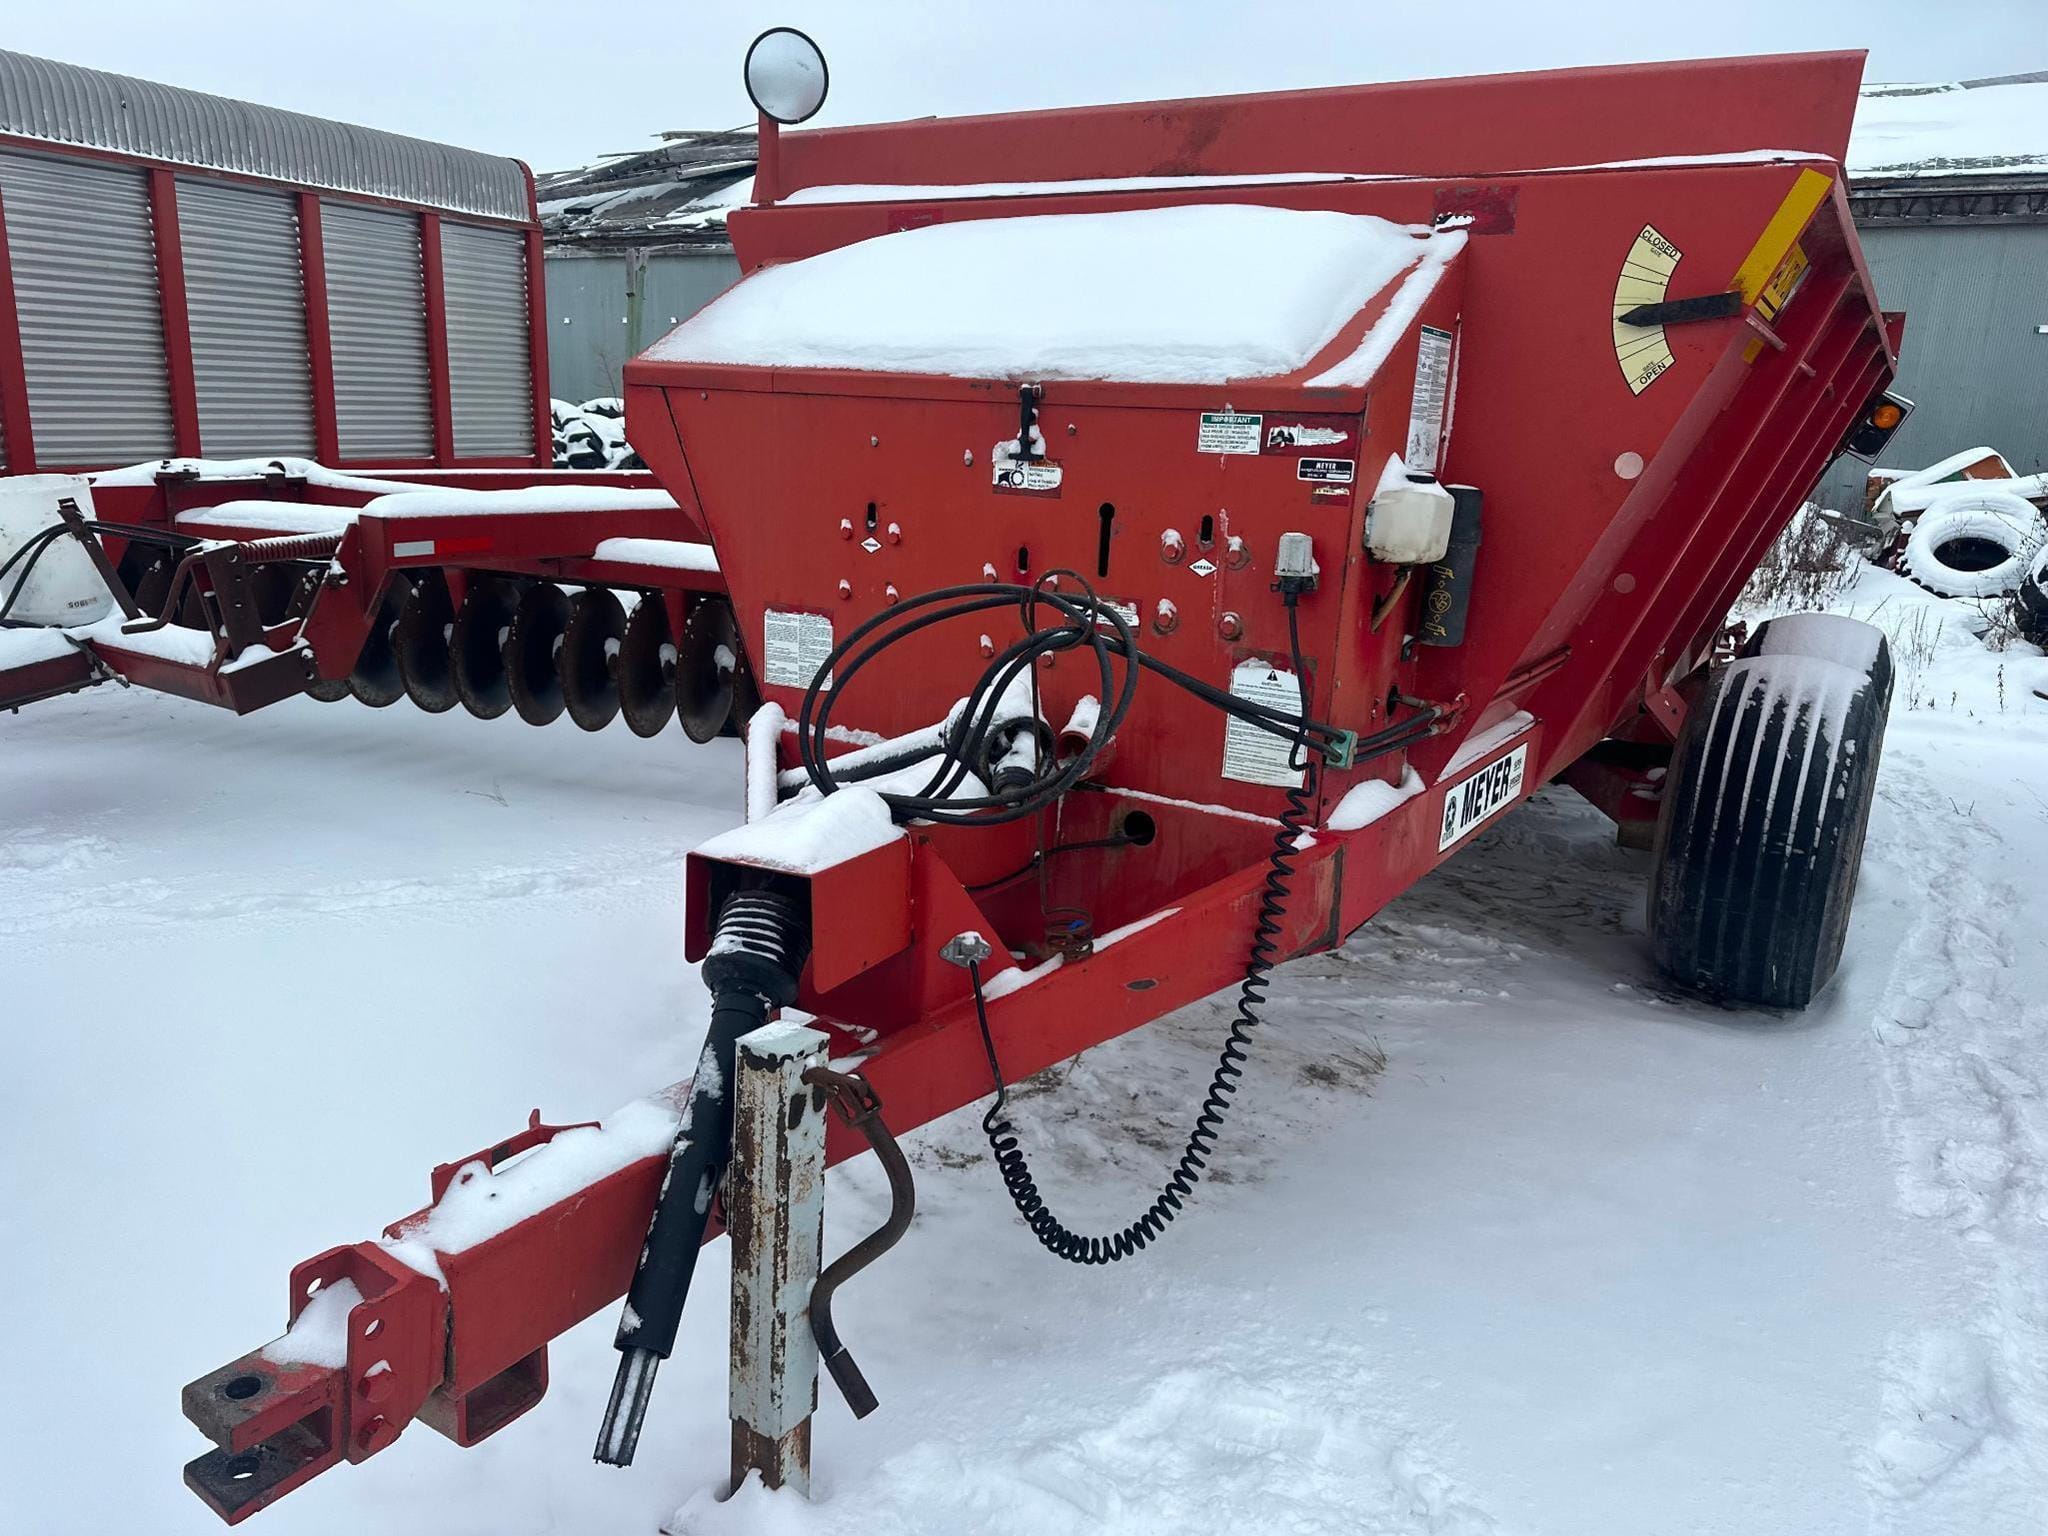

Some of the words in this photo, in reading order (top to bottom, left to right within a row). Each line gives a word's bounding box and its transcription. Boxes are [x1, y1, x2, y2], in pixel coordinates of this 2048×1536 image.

[1641, 229, 1678, 258] CLOSED
[1639, 362, 1667, 385] OPEN
[1210, 416, 1251, 424] IMPORTANT
[1316, 462, 1337, 470] MEYER
[1460, 756, 1512, 829] MEYER
